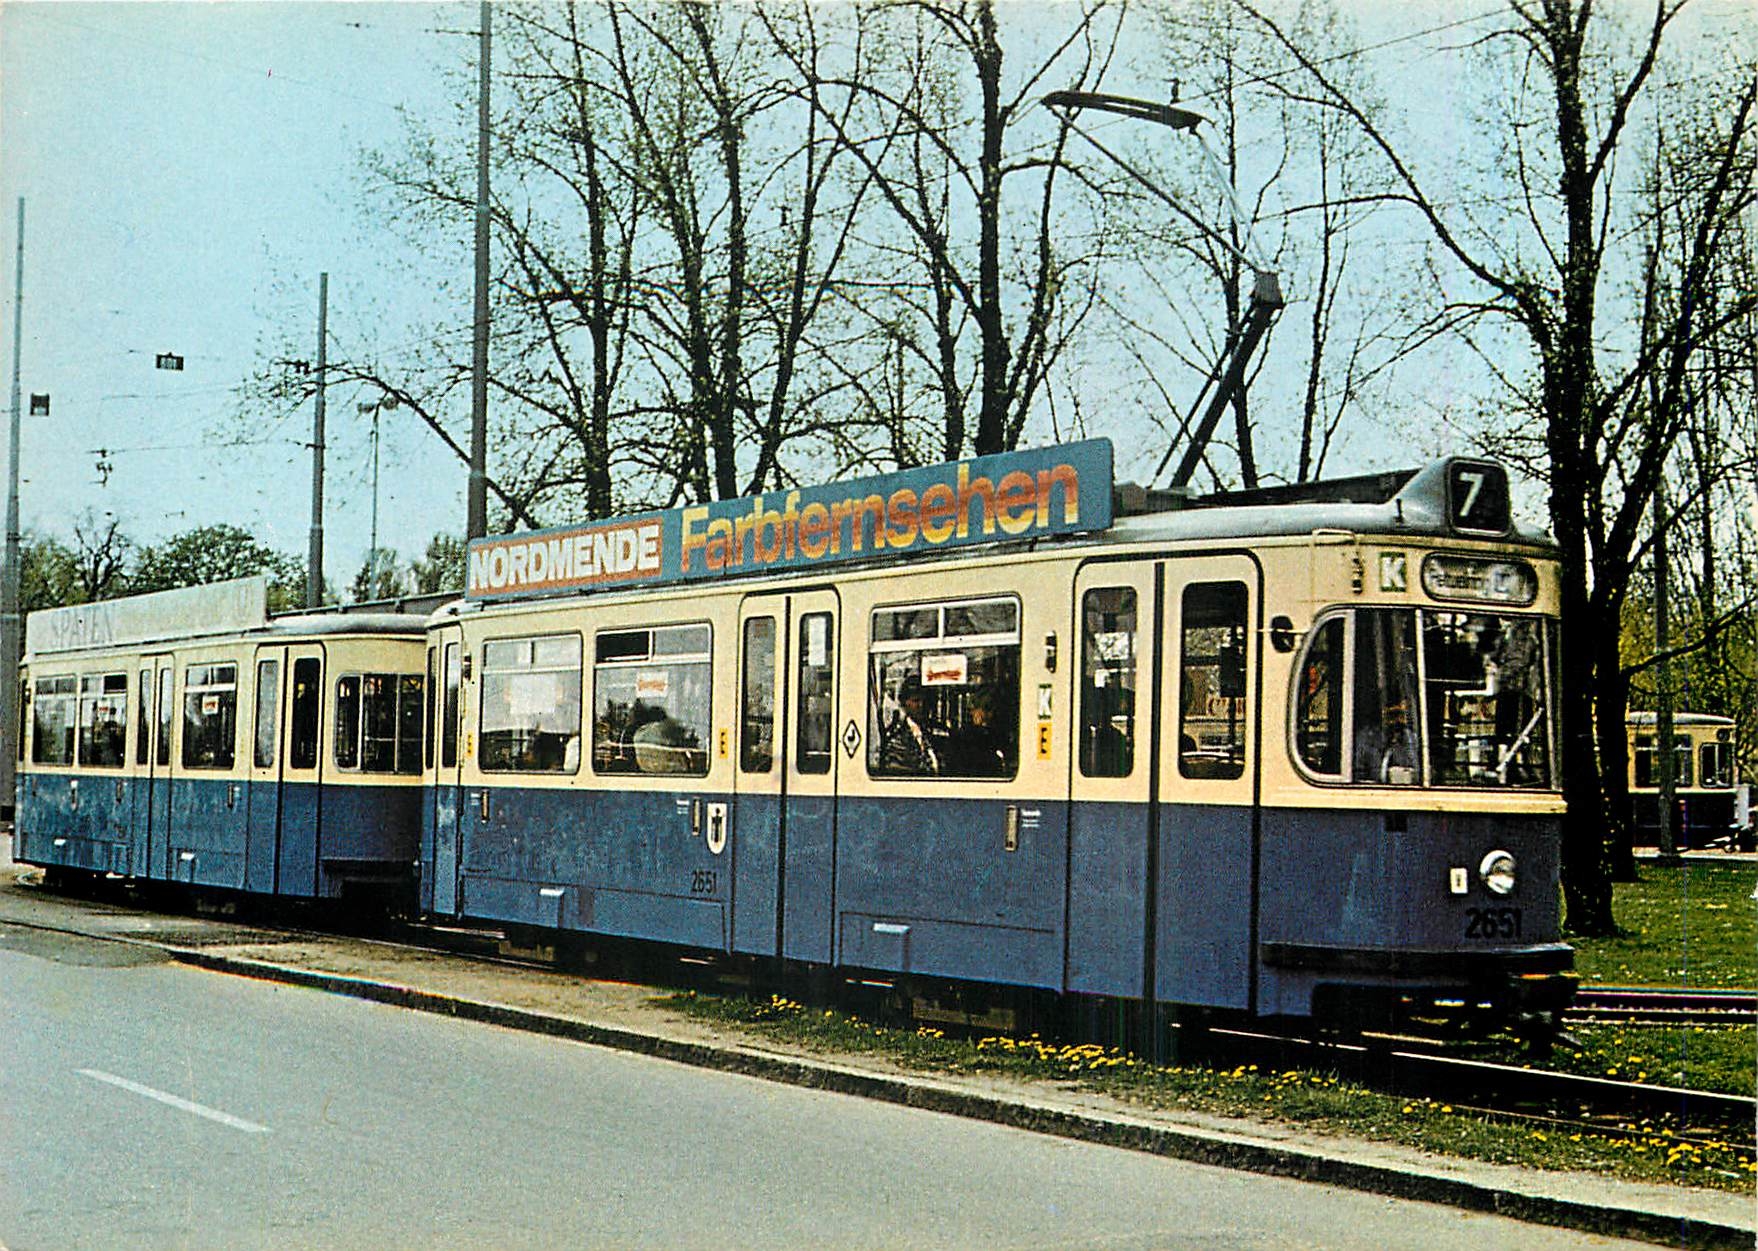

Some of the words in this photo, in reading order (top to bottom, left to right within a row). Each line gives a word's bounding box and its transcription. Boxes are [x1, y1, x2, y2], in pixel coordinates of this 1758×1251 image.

[1459, 471, 1485, 517] 7
[469, 523, 660, 591] NORDMENDE
[680, 462, 1079, 573] Farbfernsehen
[1382, 556, 1405, 588] K
[1039, 686, 1051, 716] K
[1040, 726, 1048, 755] E
[690, 870, 718, 895] 2651
[1464, 907, 1522, 939] 2651
